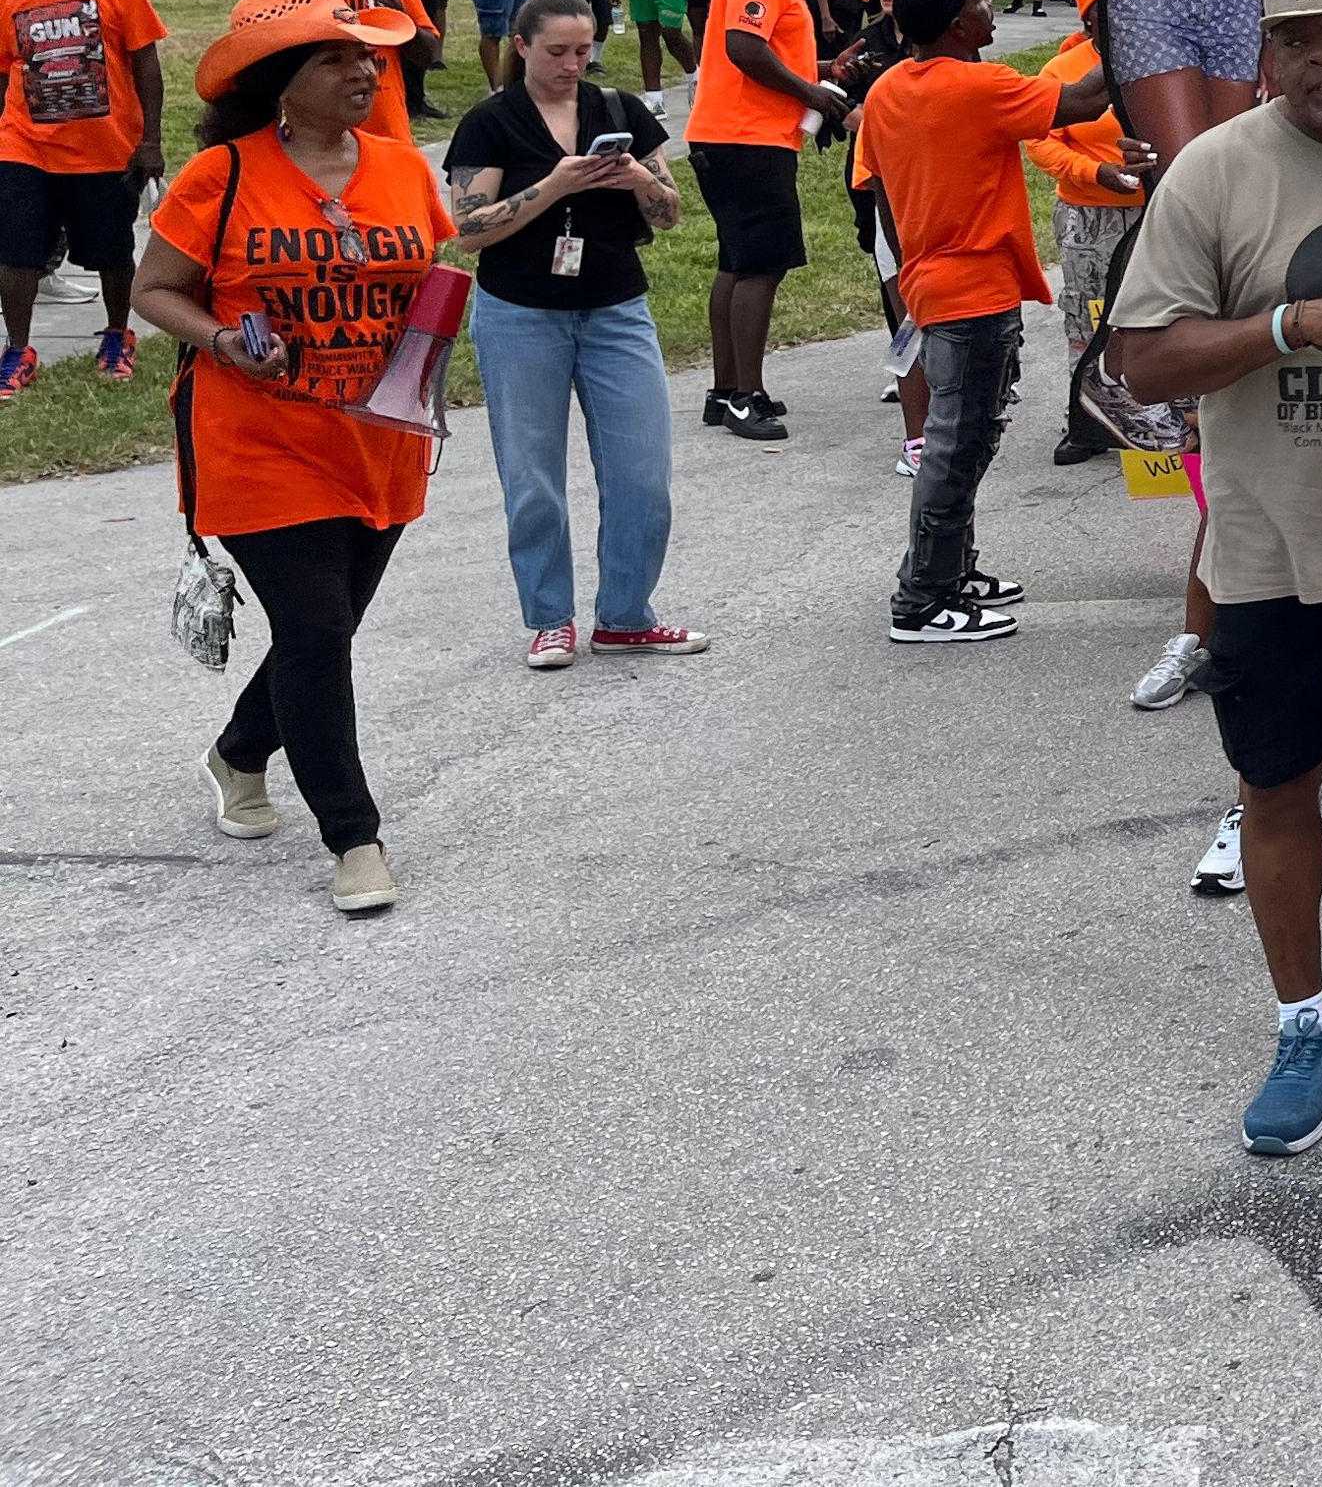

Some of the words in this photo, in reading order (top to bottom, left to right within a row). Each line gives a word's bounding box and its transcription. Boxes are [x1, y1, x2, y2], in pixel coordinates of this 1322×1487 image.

[29, 16, 81, 43] GUN
[315, 264, 359, 283] IS
[256, 282, 416, 324] ENOUGH
[1277, 403, 1299, 421] OF
